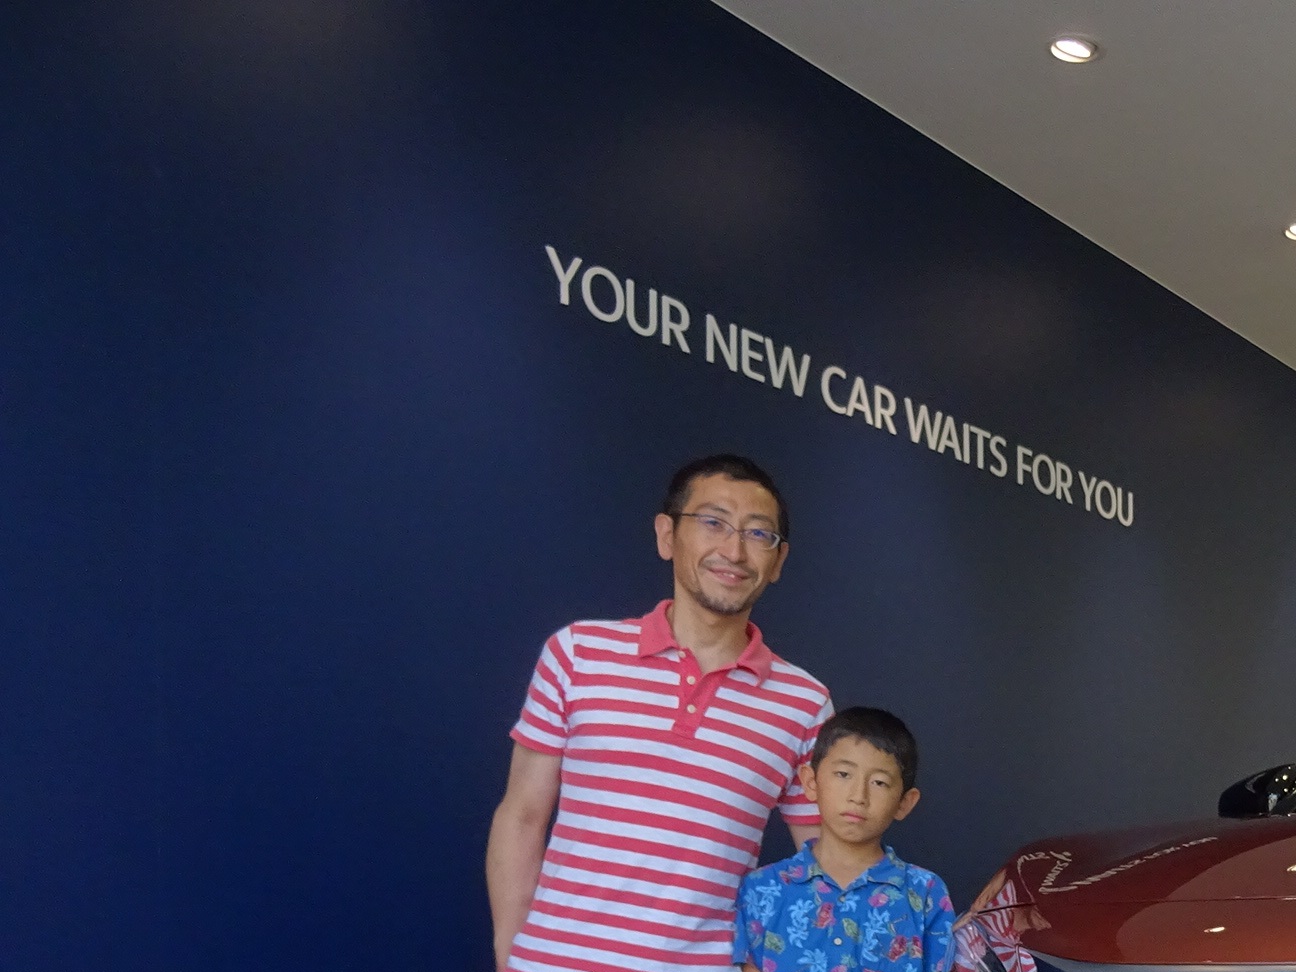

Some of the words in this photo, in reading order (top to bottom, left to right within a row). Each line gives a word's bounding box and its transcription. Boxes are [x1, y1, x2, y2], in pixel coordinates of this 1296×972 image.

[544, 245, 691, 354] YOUR
[705, 313, 811, 397] NEW
[820, 365, 898, 436] CAR
[903, 397, 1008, 478] WAITS
[1016, 445, 1073, 505] FOR
[1077, 471, 1134, 527] YOU
